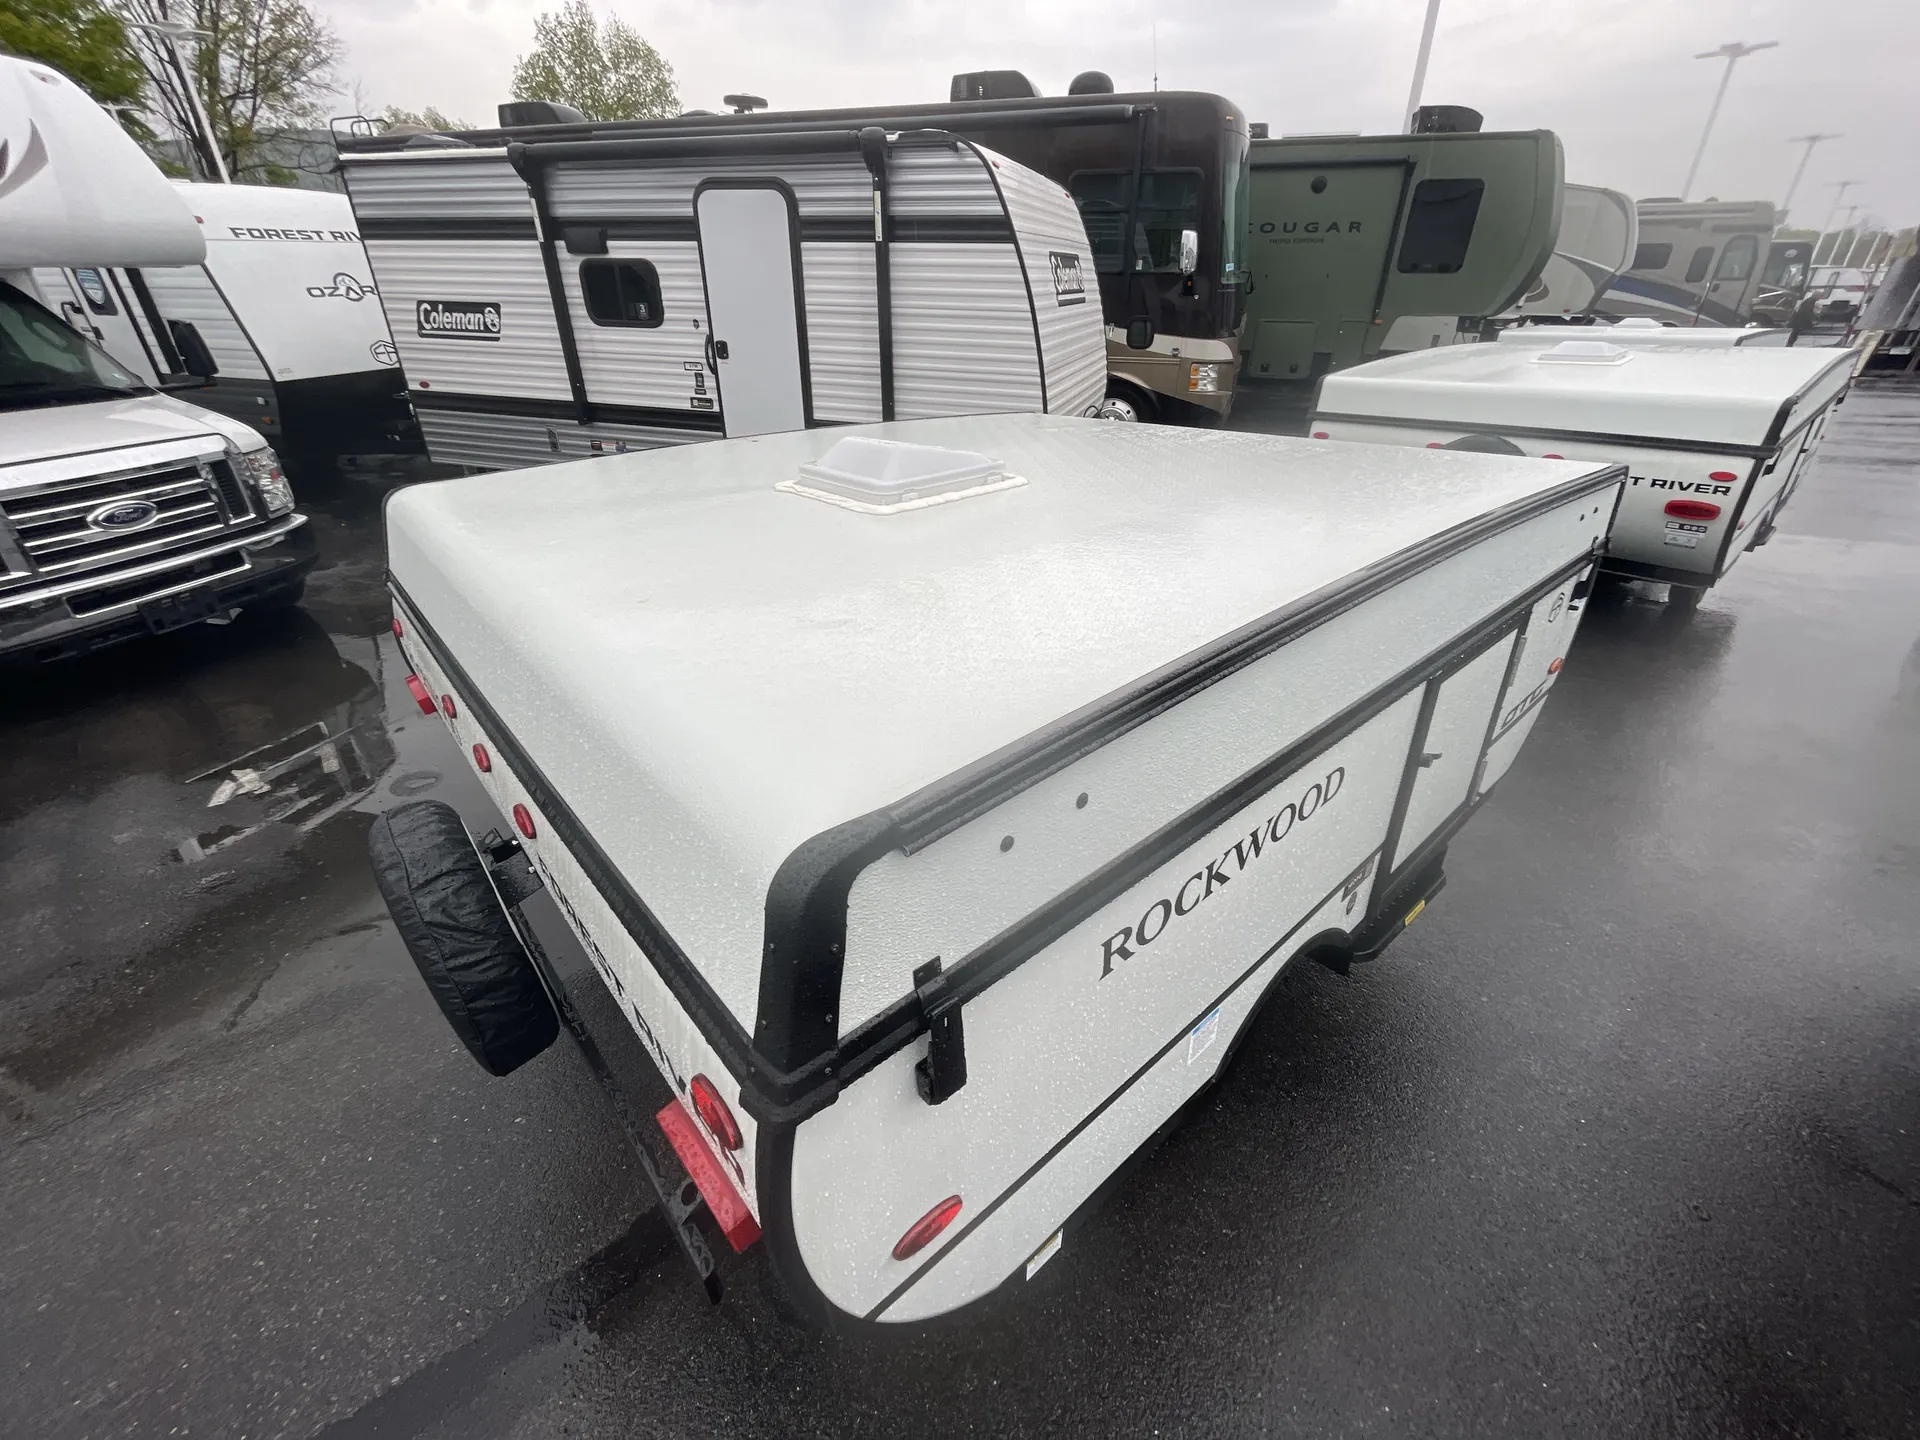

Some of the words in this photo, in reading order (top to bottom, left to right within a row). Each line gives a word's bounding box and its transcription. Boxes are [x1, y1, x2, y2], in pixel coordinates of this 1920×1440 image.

[227, 227, 324, 241] FOREST
[419, 302, 485, 331] Coleman
[1629, 475, 1645, 487] T
[1649, 477, 1732, 497] RIVER
[1098, 766, 1346, 982] ROCKWOOD
